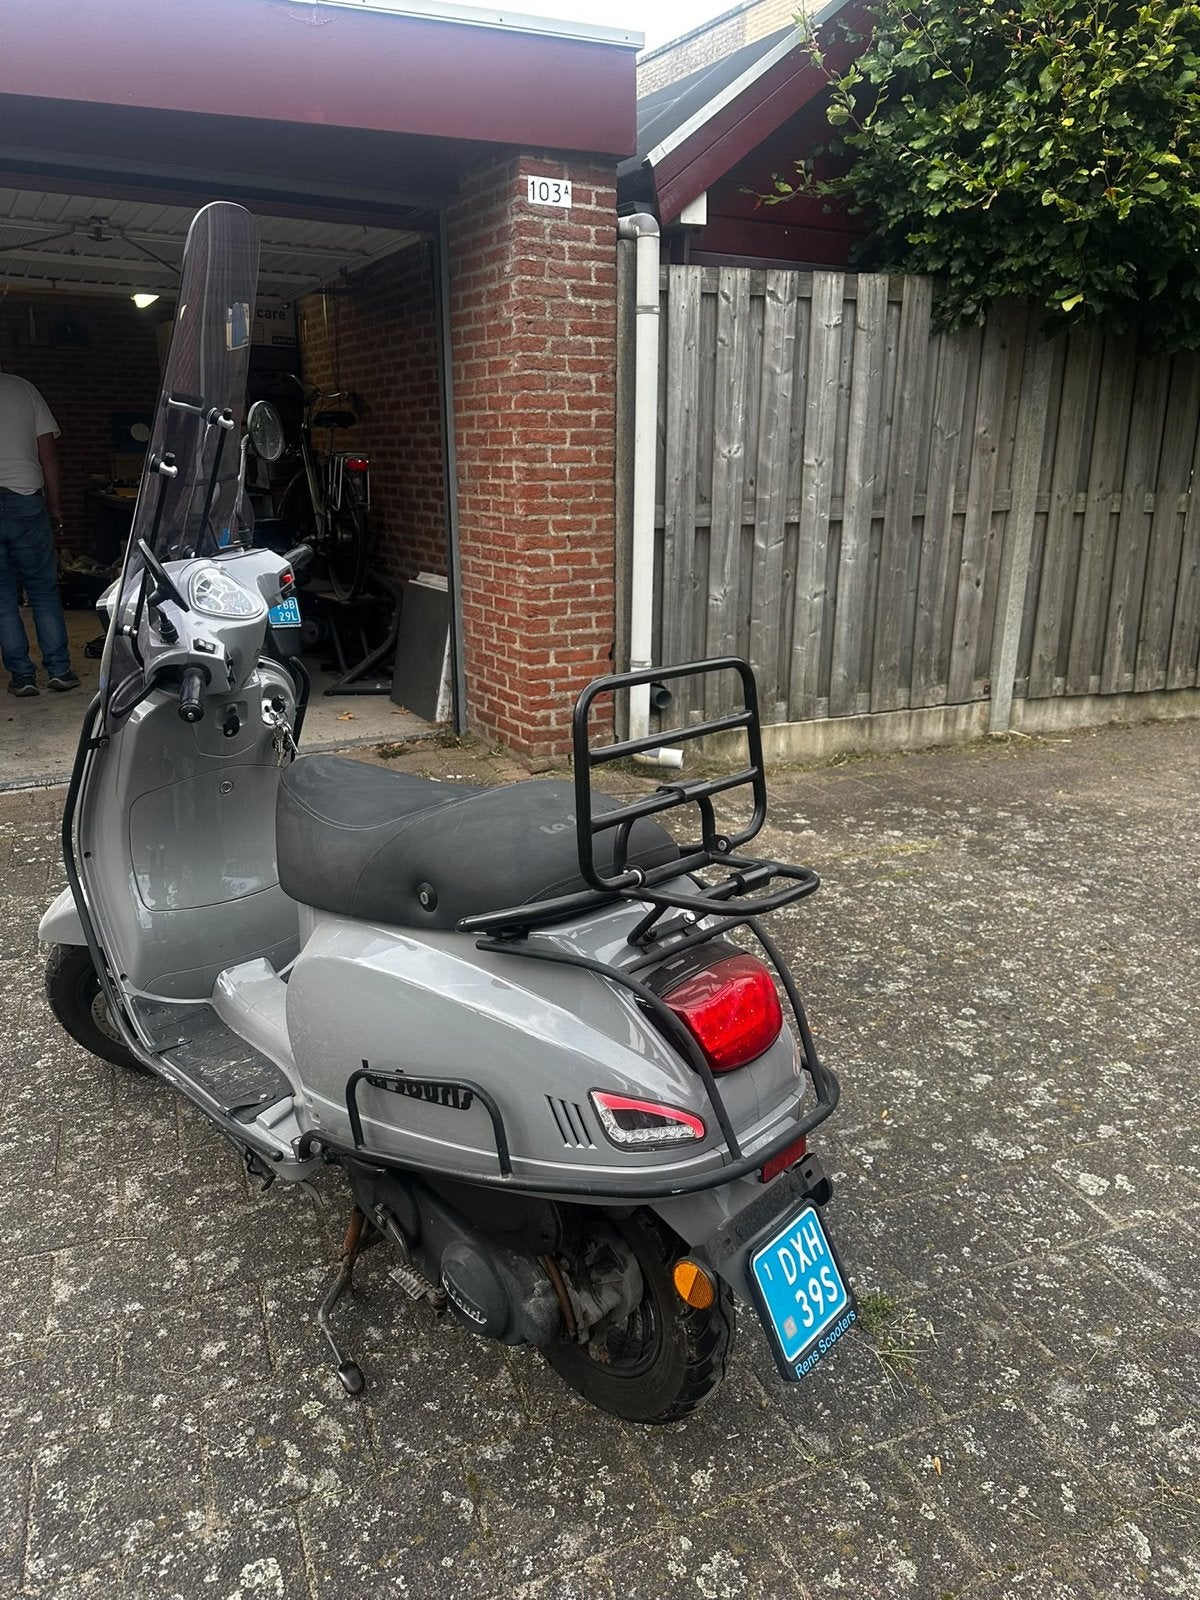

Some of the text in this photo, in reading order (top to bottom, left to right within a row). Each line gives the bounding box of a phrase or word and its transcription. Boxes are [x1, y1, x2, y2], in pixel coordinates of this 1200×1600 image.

[278, 611, 298, 622] 29L
[763, 1221, 824, 1286] 1 DXH
[795, 1265, 838, 1328] 39S
[794, 1309, 857, 1380] Rens Scooters
